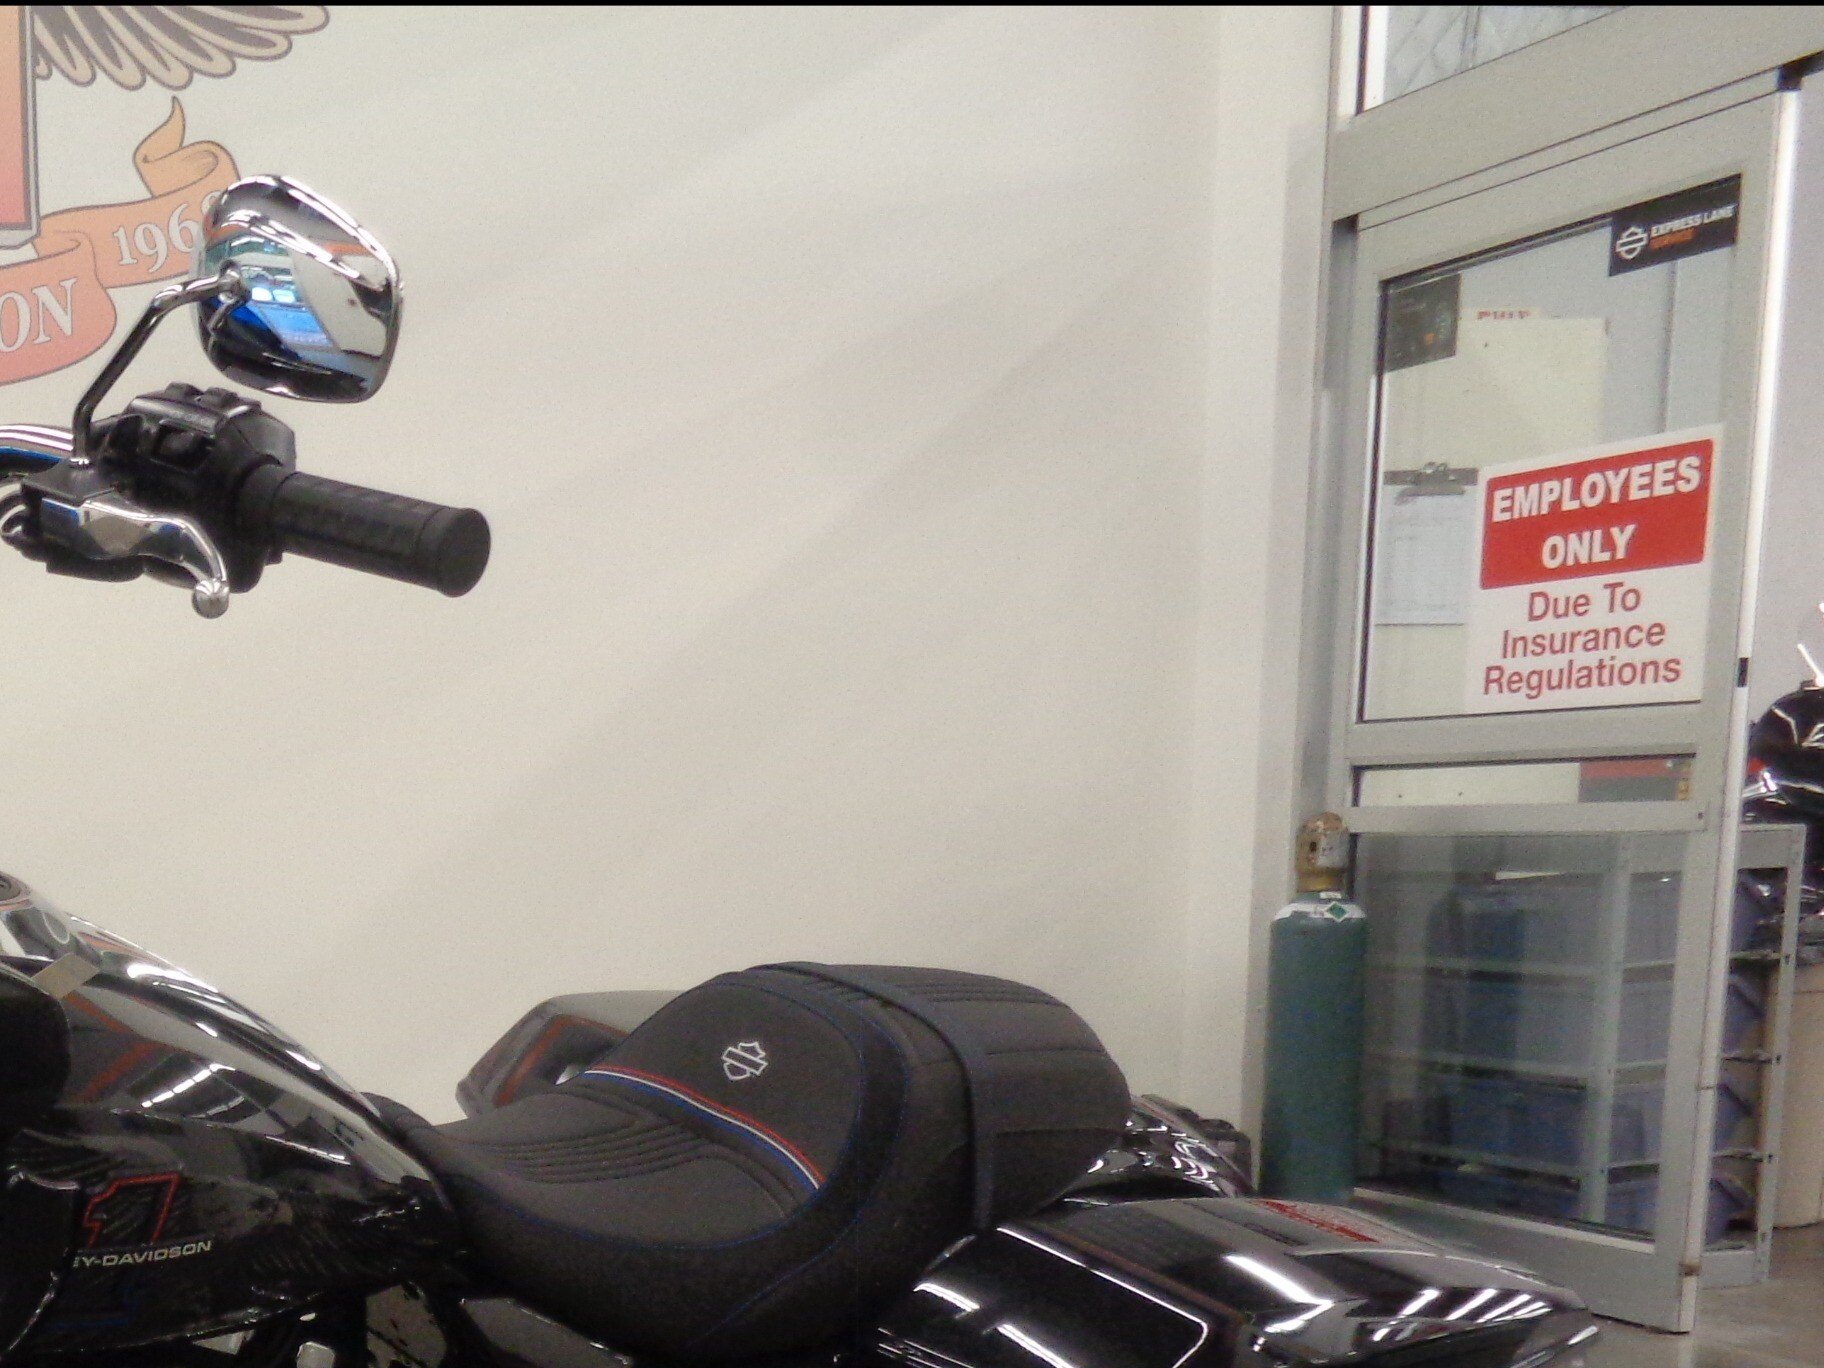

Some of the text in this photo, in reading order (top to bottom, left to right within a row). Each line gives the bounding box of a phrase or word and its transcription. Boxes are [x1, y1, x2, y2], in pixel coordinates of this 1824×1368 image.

[111, 189, 222, 274] 196
[1491, 454, 1703, 523] EMPLOYEES
[1541, 524, 1636, 569] ONLY
[1527, 581, 1642, 622] Due To
[1501, 621, 1666, 660] Insurance
[1483, 652, 1682, 699] Regulations
